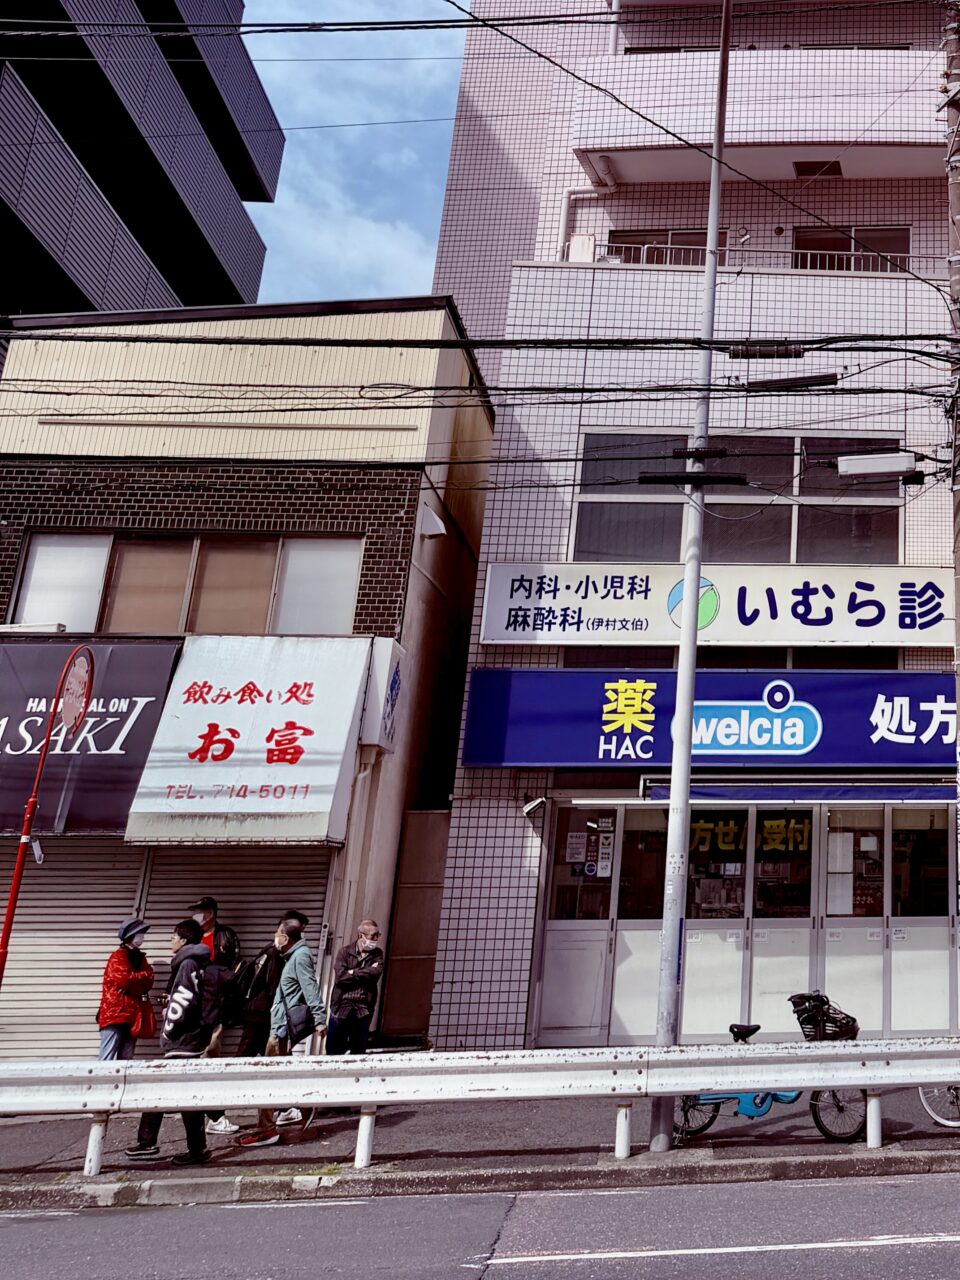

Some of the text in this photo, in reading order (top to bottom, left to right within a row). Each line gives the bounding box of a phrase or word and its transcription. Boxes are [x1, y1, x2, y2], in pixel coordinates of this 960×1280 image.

[509, 574, 651, 600] 内科・小児科
[183, 681, 315, 705] 飲み食い処
[602, 679, 657, 733] 薬
[0, 697, 156, 755] SAKI
[188, 721, 315, 764] お富
[691, 710, 804, 746] welcia
[598, 735, 654, 759] HAC
